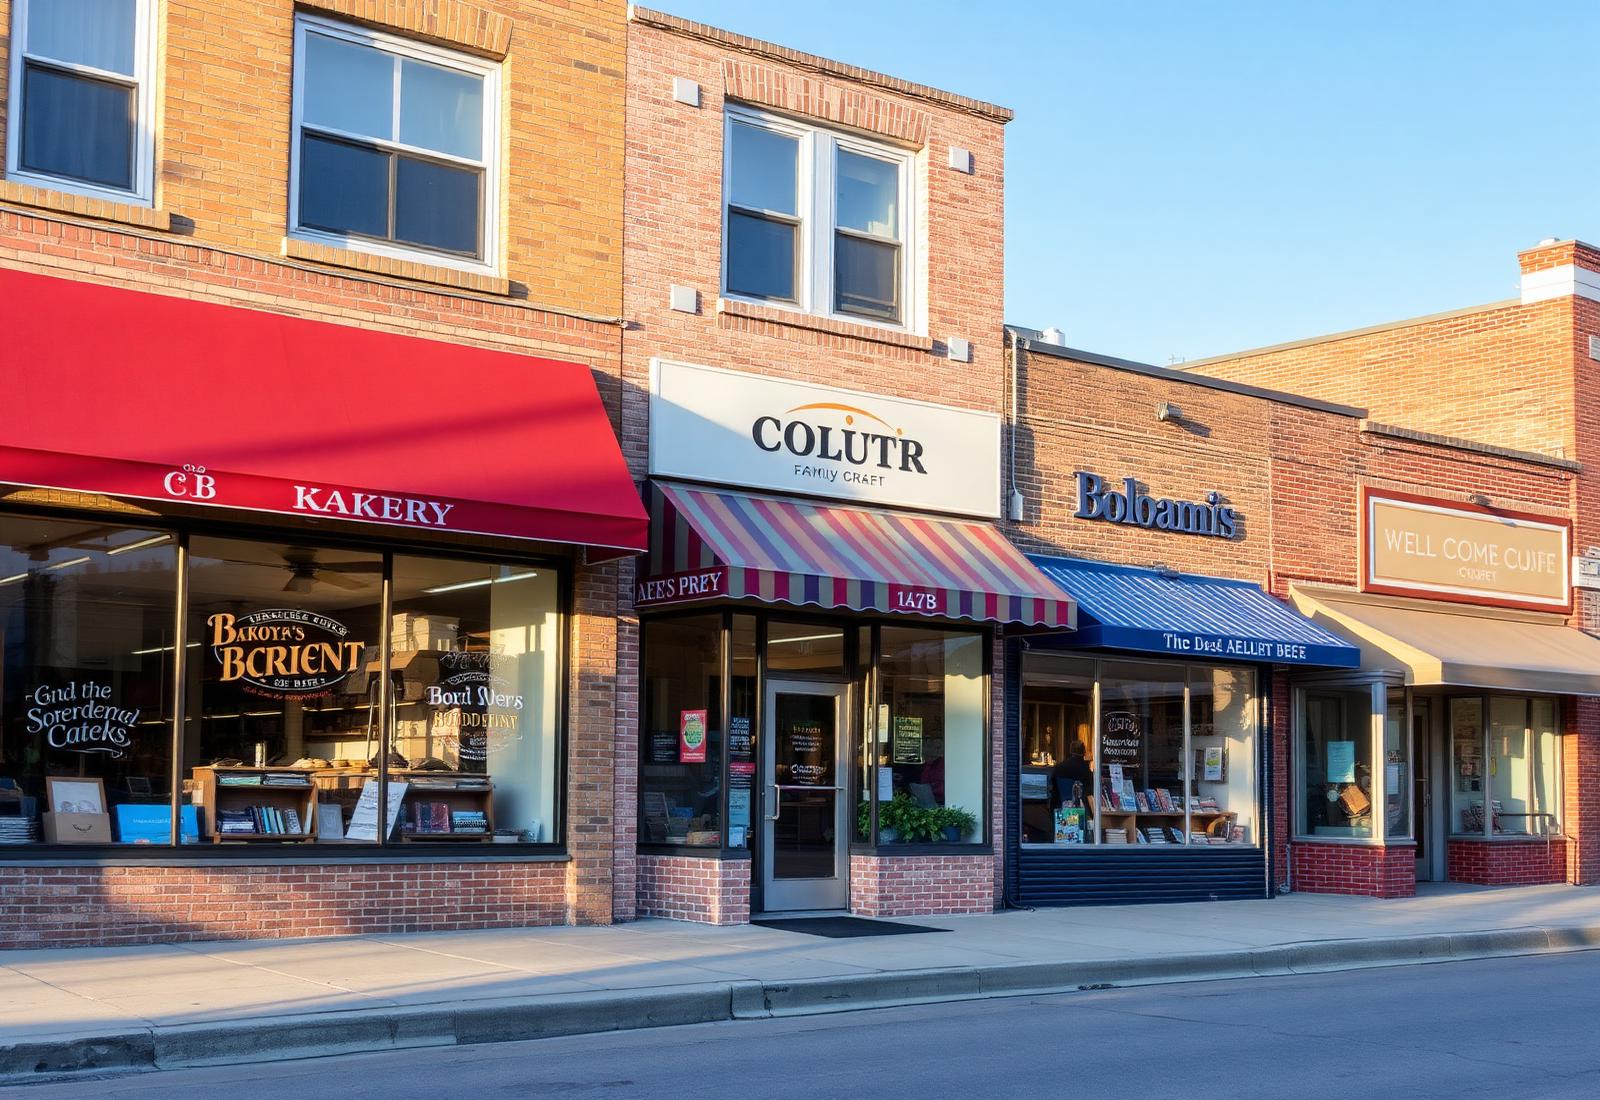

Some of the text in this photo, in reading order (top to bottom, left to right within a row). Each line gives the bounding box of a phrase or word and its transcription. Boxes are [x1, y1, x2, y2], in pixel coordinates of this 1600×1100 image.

[752, 416, 928, 475] COLUTR
[294, 485, 454, 526] KAKERY
[1384, 528, 1437, 557] WELL
[1443, 537, 1500, 566] COME
[1163, 632, 1191, 650] The
[219, 641, 365, 682] BCRIENT
[81, 681, 112, 699] the
